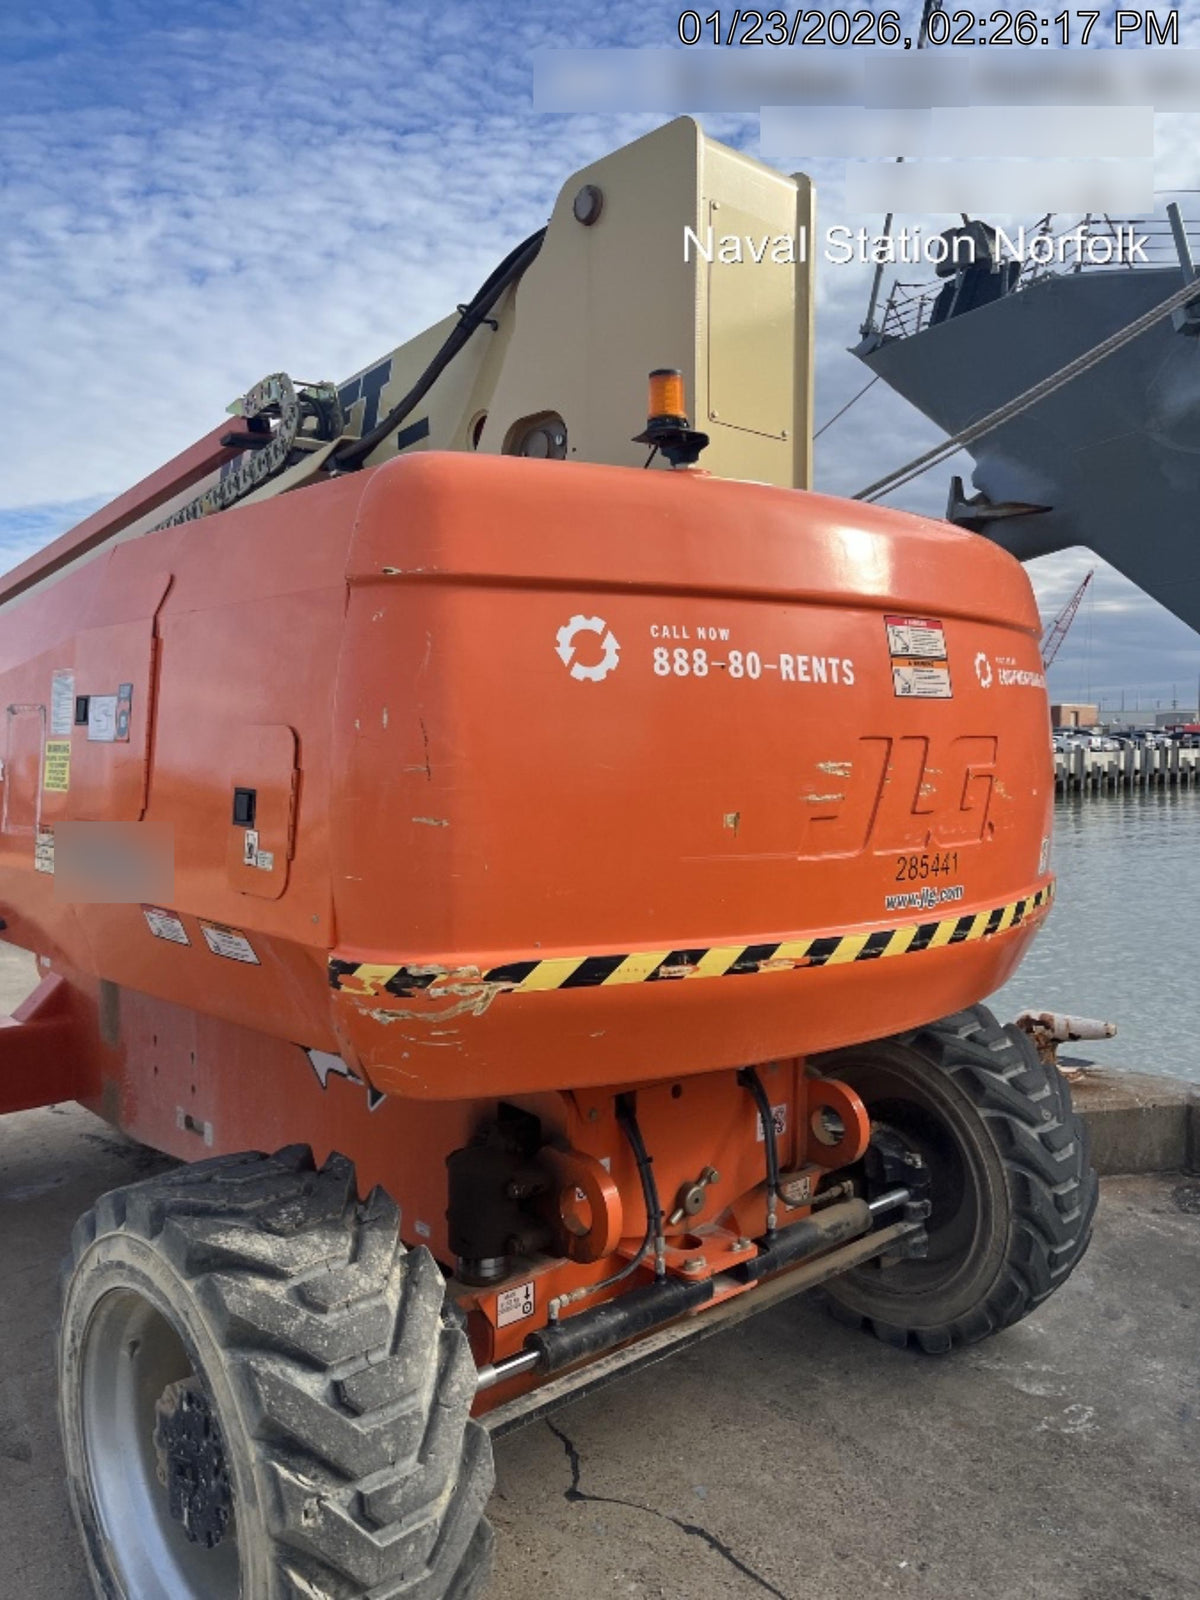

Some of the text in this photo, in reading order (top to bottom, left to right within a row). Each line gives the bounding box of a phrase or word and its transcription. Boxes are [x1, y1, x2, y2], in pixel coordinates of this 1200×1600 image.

[650, 625, 730, 641] CALL NOW
[653, 647, 855, 686] 888-80-RENTS
[895, 853, 959, 882] 285441
[885, 885, 965, 911] www.jlg.com
